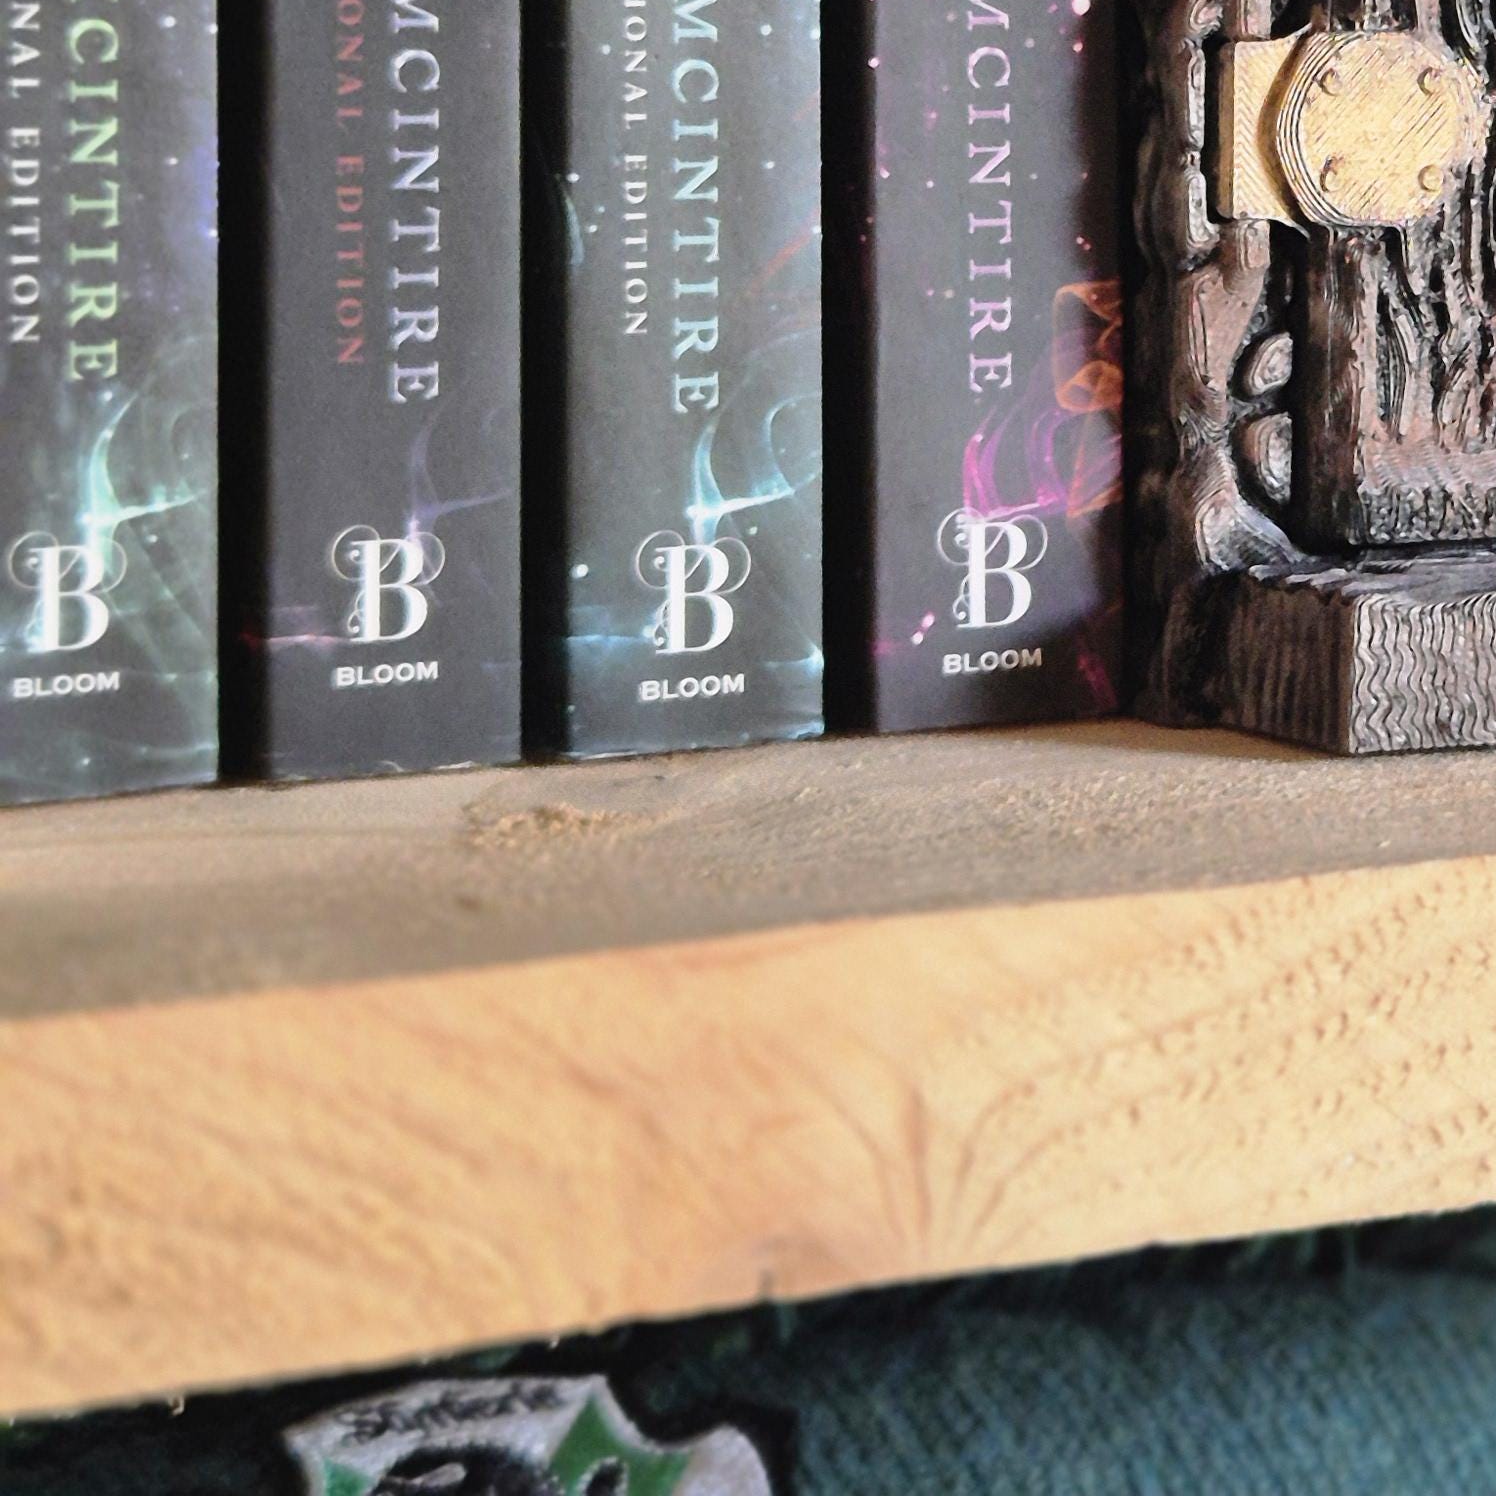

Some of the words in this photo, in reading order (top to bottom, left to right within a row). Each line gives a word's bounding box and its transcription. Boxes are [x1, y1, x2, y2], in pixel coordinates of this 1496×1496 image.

[8, 127, 41, 343] EDITION
[336, 155, 365, 365] EDITION
[624, 154, 648, 336] EDITION
[8, 530, 127, 653] B
[331, 524, 446, 644] B
[635, 530, 751, 656] B
[936, 508, 1048, 629] B
[13, 671, 121, 699] BLOOM
[334, 660, 439, 688] BLOOM
[640, 672, 745, 702] BLOOM
[942, 647, 1043, 675] BLOOM
